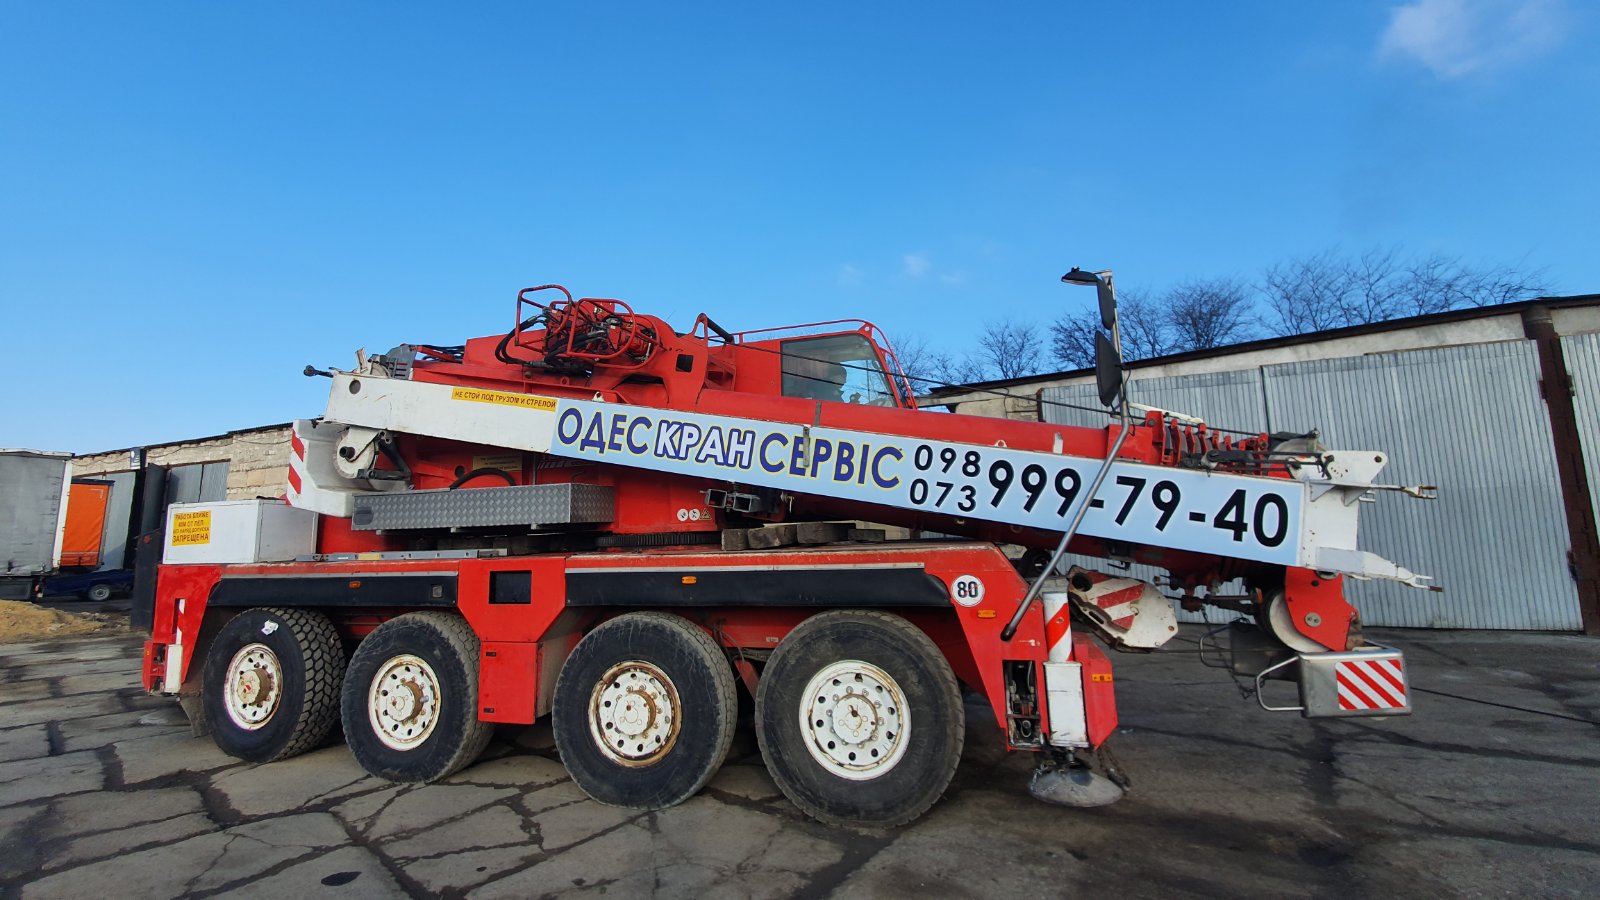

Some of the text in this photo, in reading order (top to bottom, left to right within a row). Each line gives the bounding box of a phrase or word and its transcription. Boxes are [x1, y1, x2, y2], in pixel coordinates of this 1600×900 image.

[464, 391, 480, 400] СТОЙ
[481, 393, 494, 402] ПОД
[495, 395, 520, 404] ГРУЗОМ
[526, 399, 556, 408] СТРЕЛОЙ
[914, 444, 981, 477] 098
[909, 478, 977, 512] 073
[173, 533, 209, 543] ЗАПРЕЩЕНА
[957, 581, 979, 598] 80
